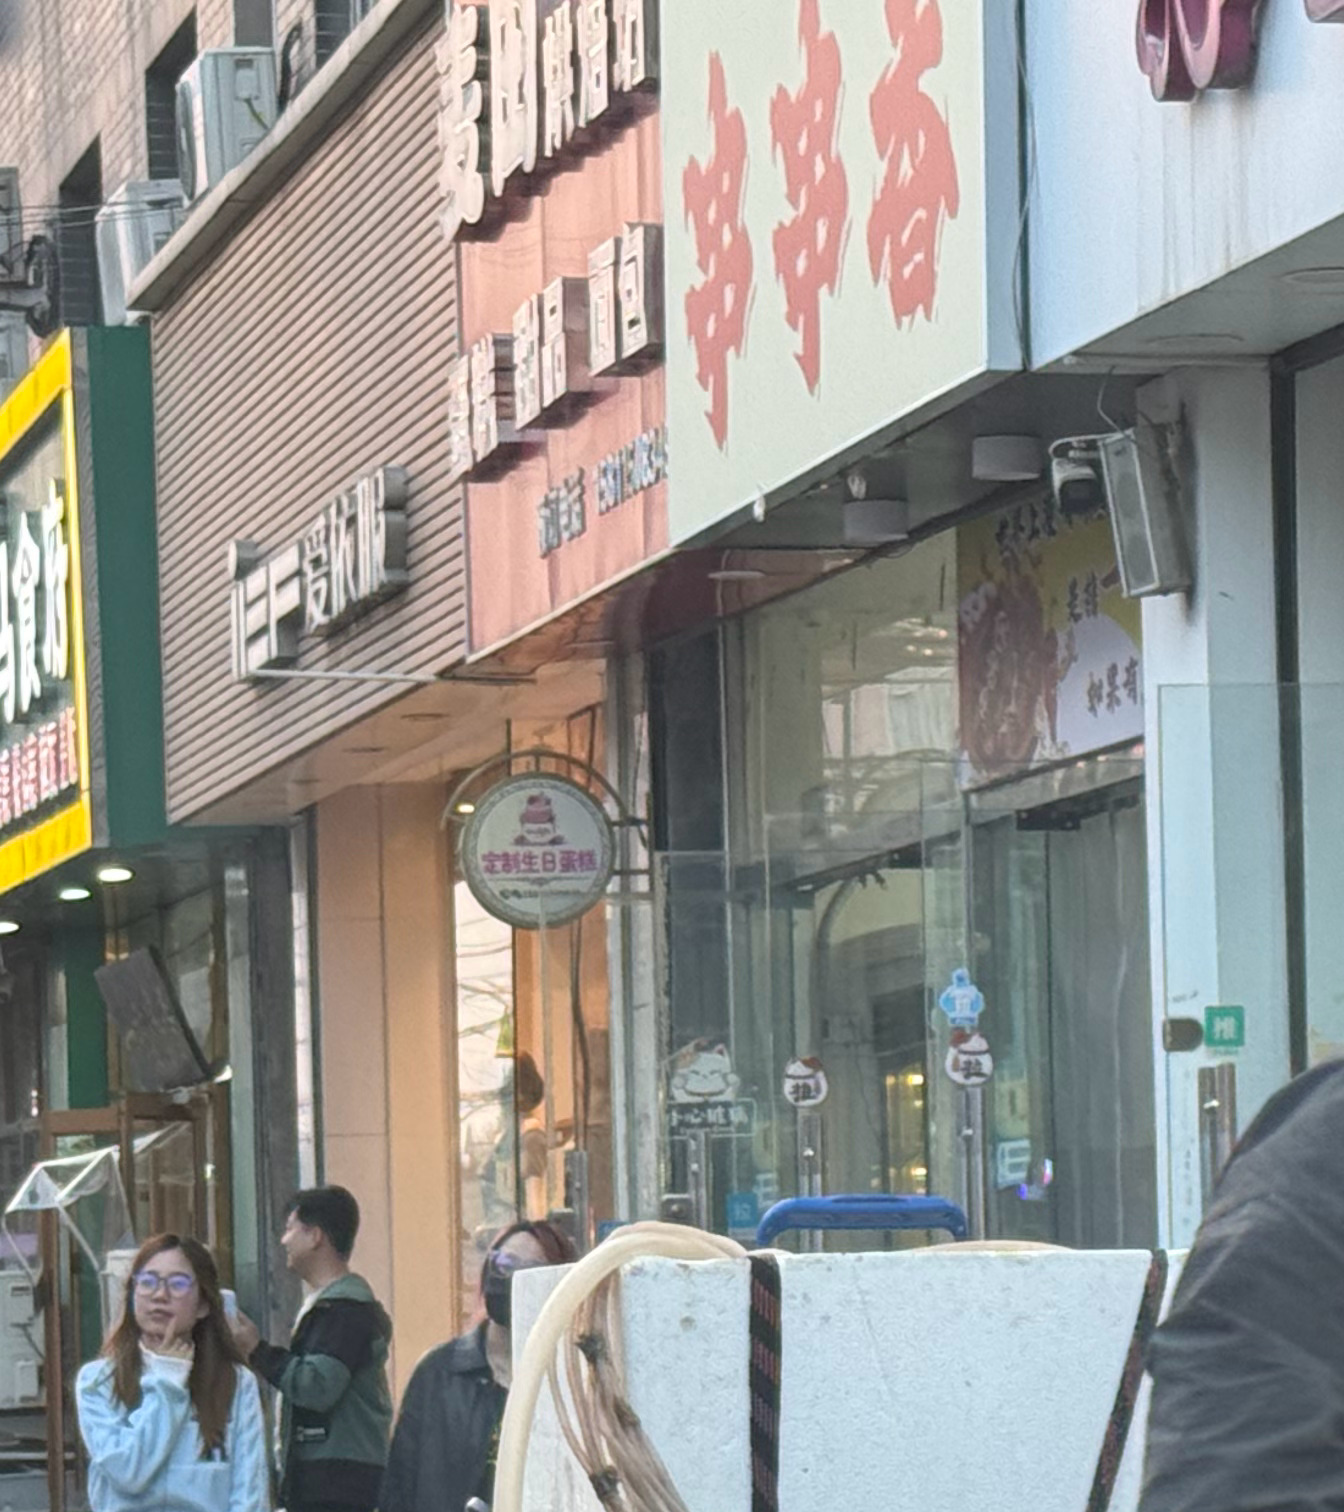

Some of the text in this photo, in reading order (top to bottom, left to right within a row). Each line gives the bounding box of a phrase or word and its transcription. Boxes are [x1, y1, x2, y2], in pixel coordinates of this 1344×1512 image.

[481, 850, 598, 875] 定制生日蛋糕
